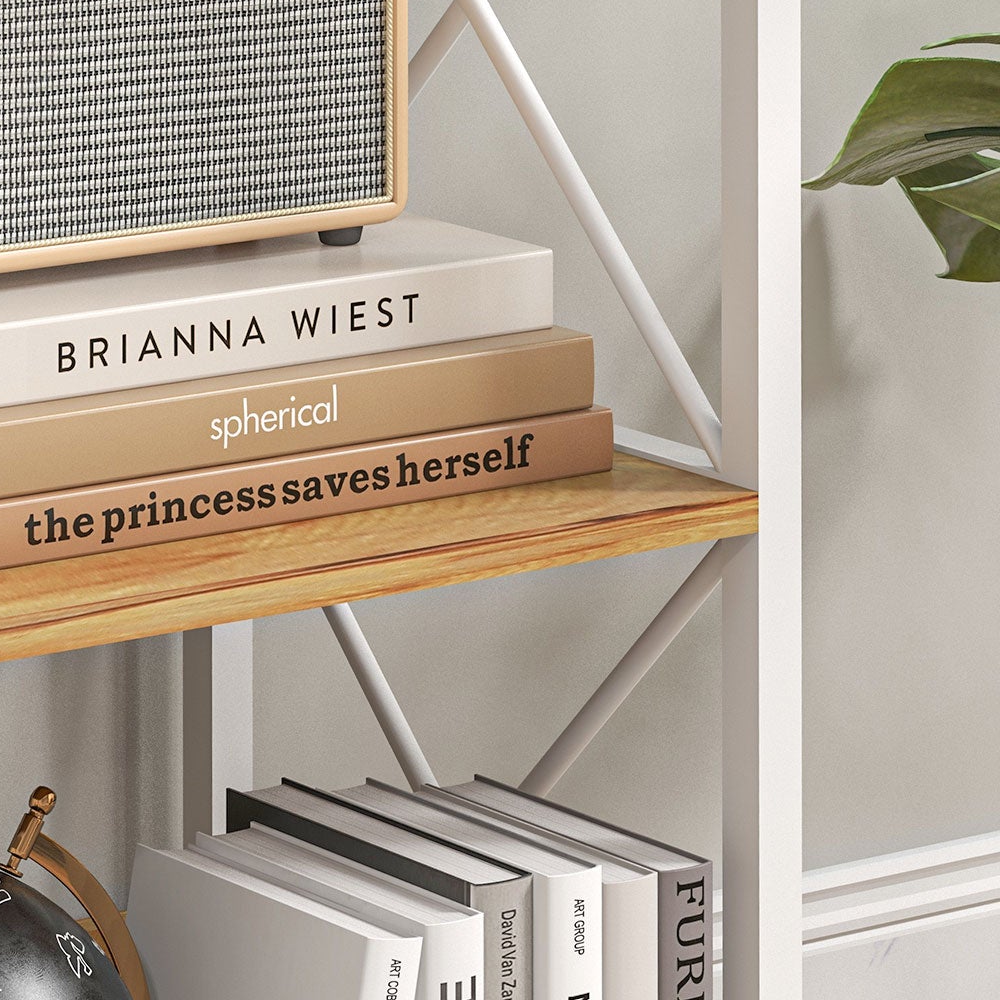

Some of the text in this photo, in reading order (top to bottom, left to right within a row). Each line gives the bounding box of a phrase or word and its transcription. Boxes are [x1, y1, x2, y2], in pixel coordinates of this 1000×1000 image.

[57, 293, 420, 374] BRIANNA WIEST
[210, 384, 339, 450] spherical
[25, 433, 535, 546] the princess saves herself
[501, 909, 517, 949] David
[573, 898, 586, 956] ART GROUP
[389, 958, 402, 979] ART
[501, 949, 517, 978] Van
